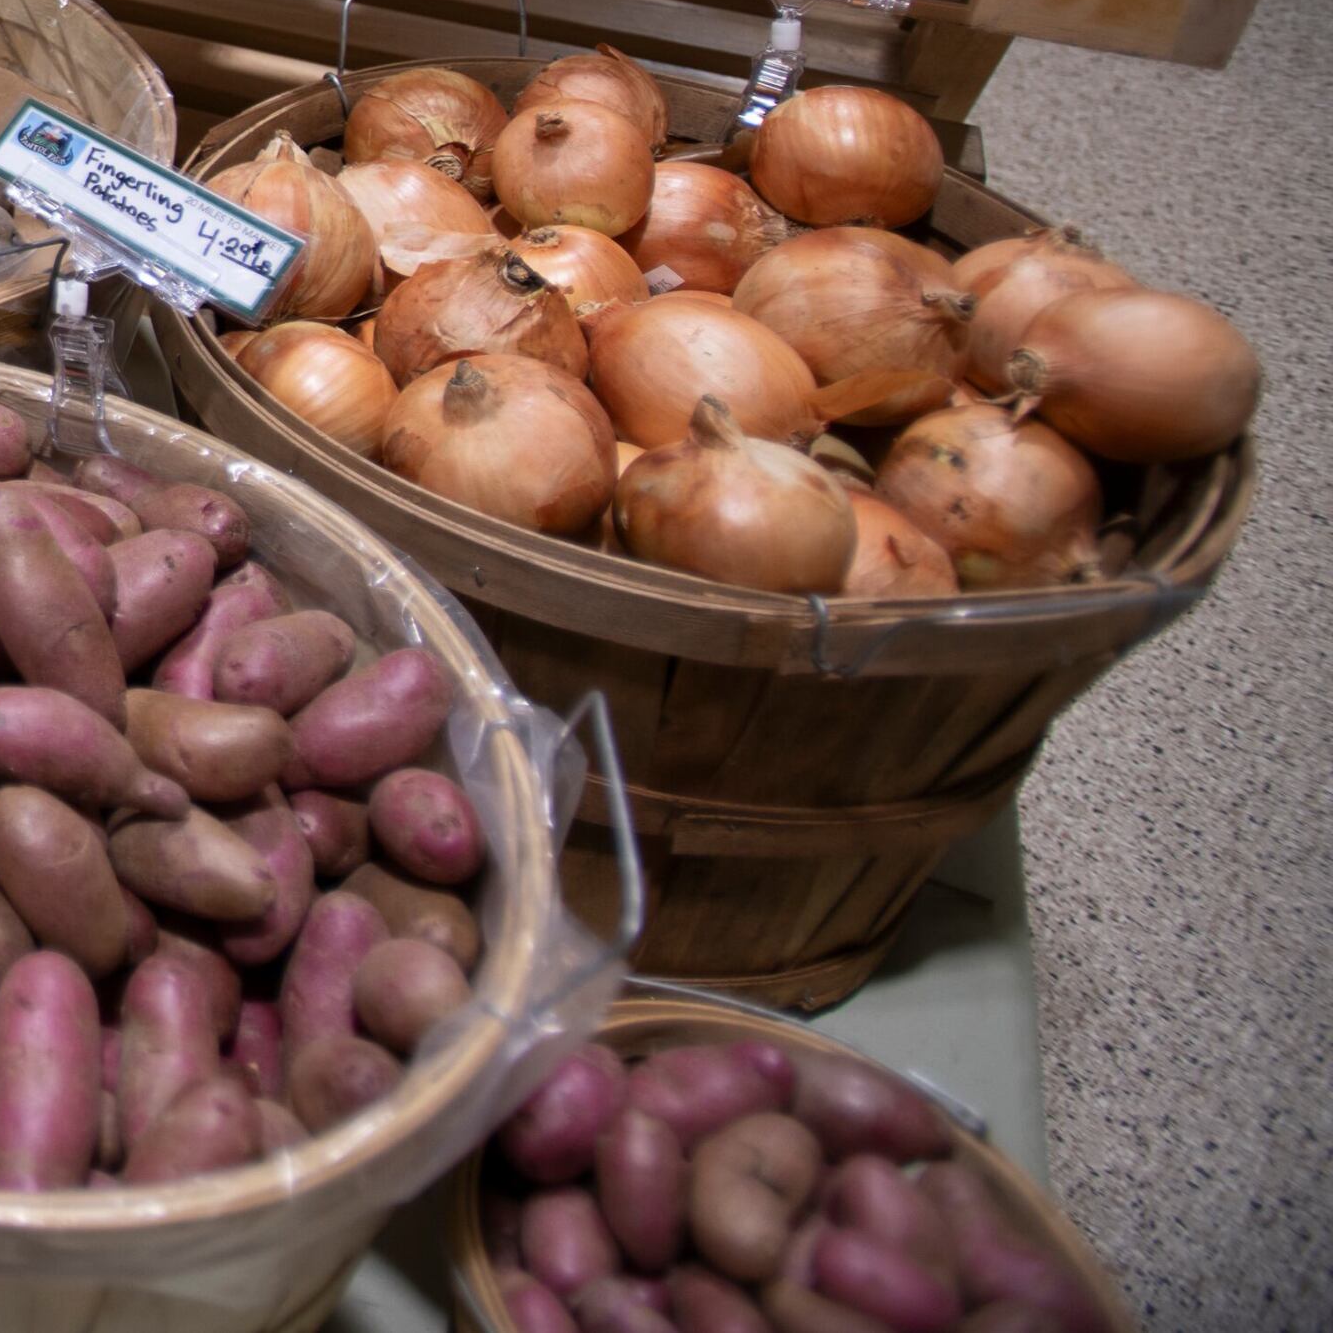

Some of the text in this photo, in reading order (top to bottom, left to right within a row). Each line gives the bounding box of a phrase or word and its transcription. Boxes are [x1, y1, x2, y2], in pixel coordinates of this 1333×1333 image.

[83, 171, 158, 232] Potatoes
[85, 146, 184, 224] Fingerling
[184, 195, 199, 208] 20
[198, 204, 227, 223] MILES
[227, 218, 242, 231] TO
[197, 220, 253, 263] 4.29
